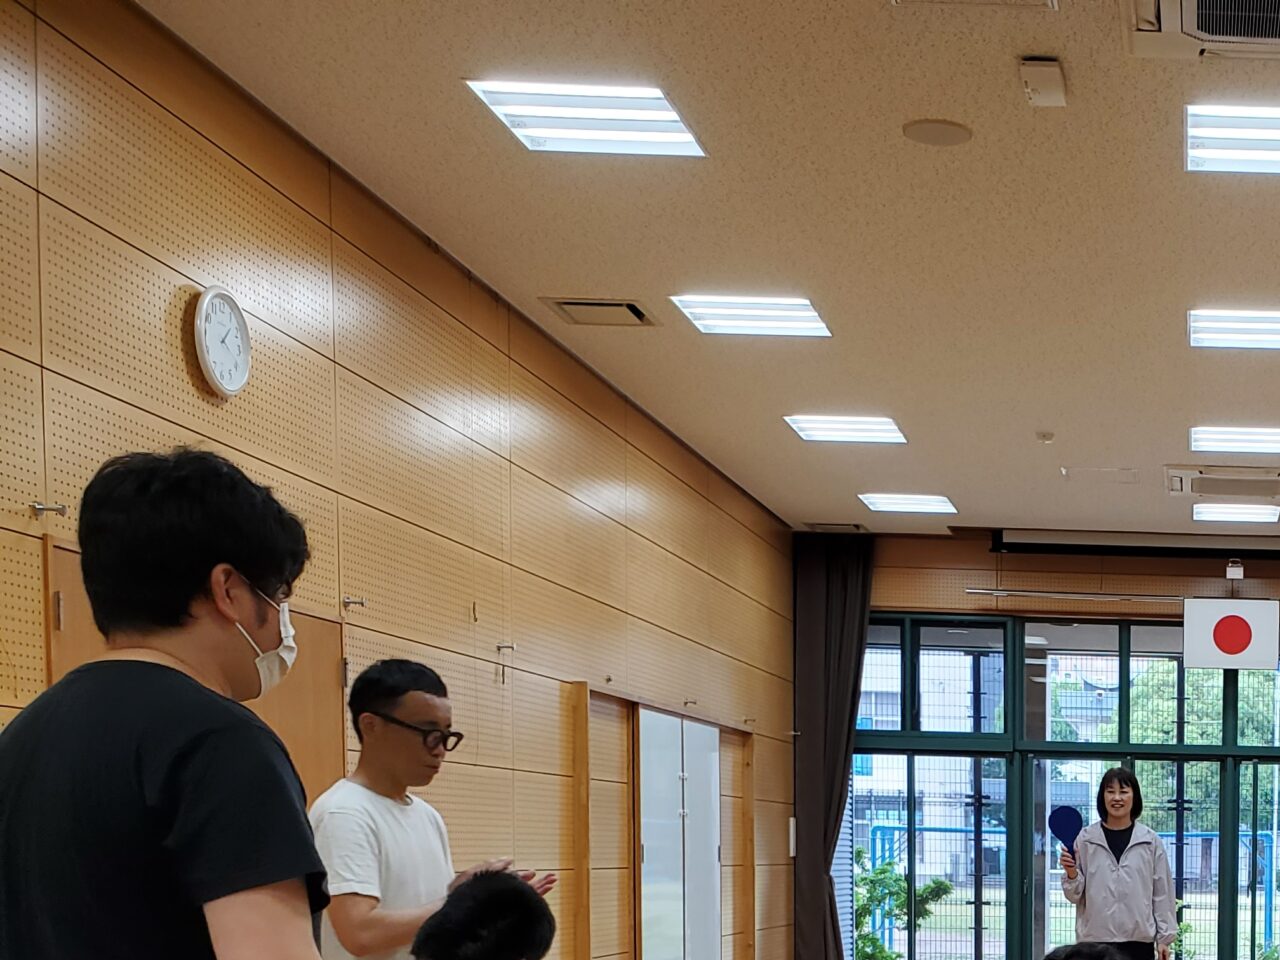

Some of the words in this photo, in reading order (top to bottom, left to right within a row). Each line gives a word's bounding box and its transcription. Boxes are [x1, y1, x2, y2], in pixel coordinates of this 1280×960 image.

[211, 301, 217, 315] 11
[218, 300, 226, 314] 12
[219, 370, 225, 381] 6
[228, 369, 233, 381] 5
